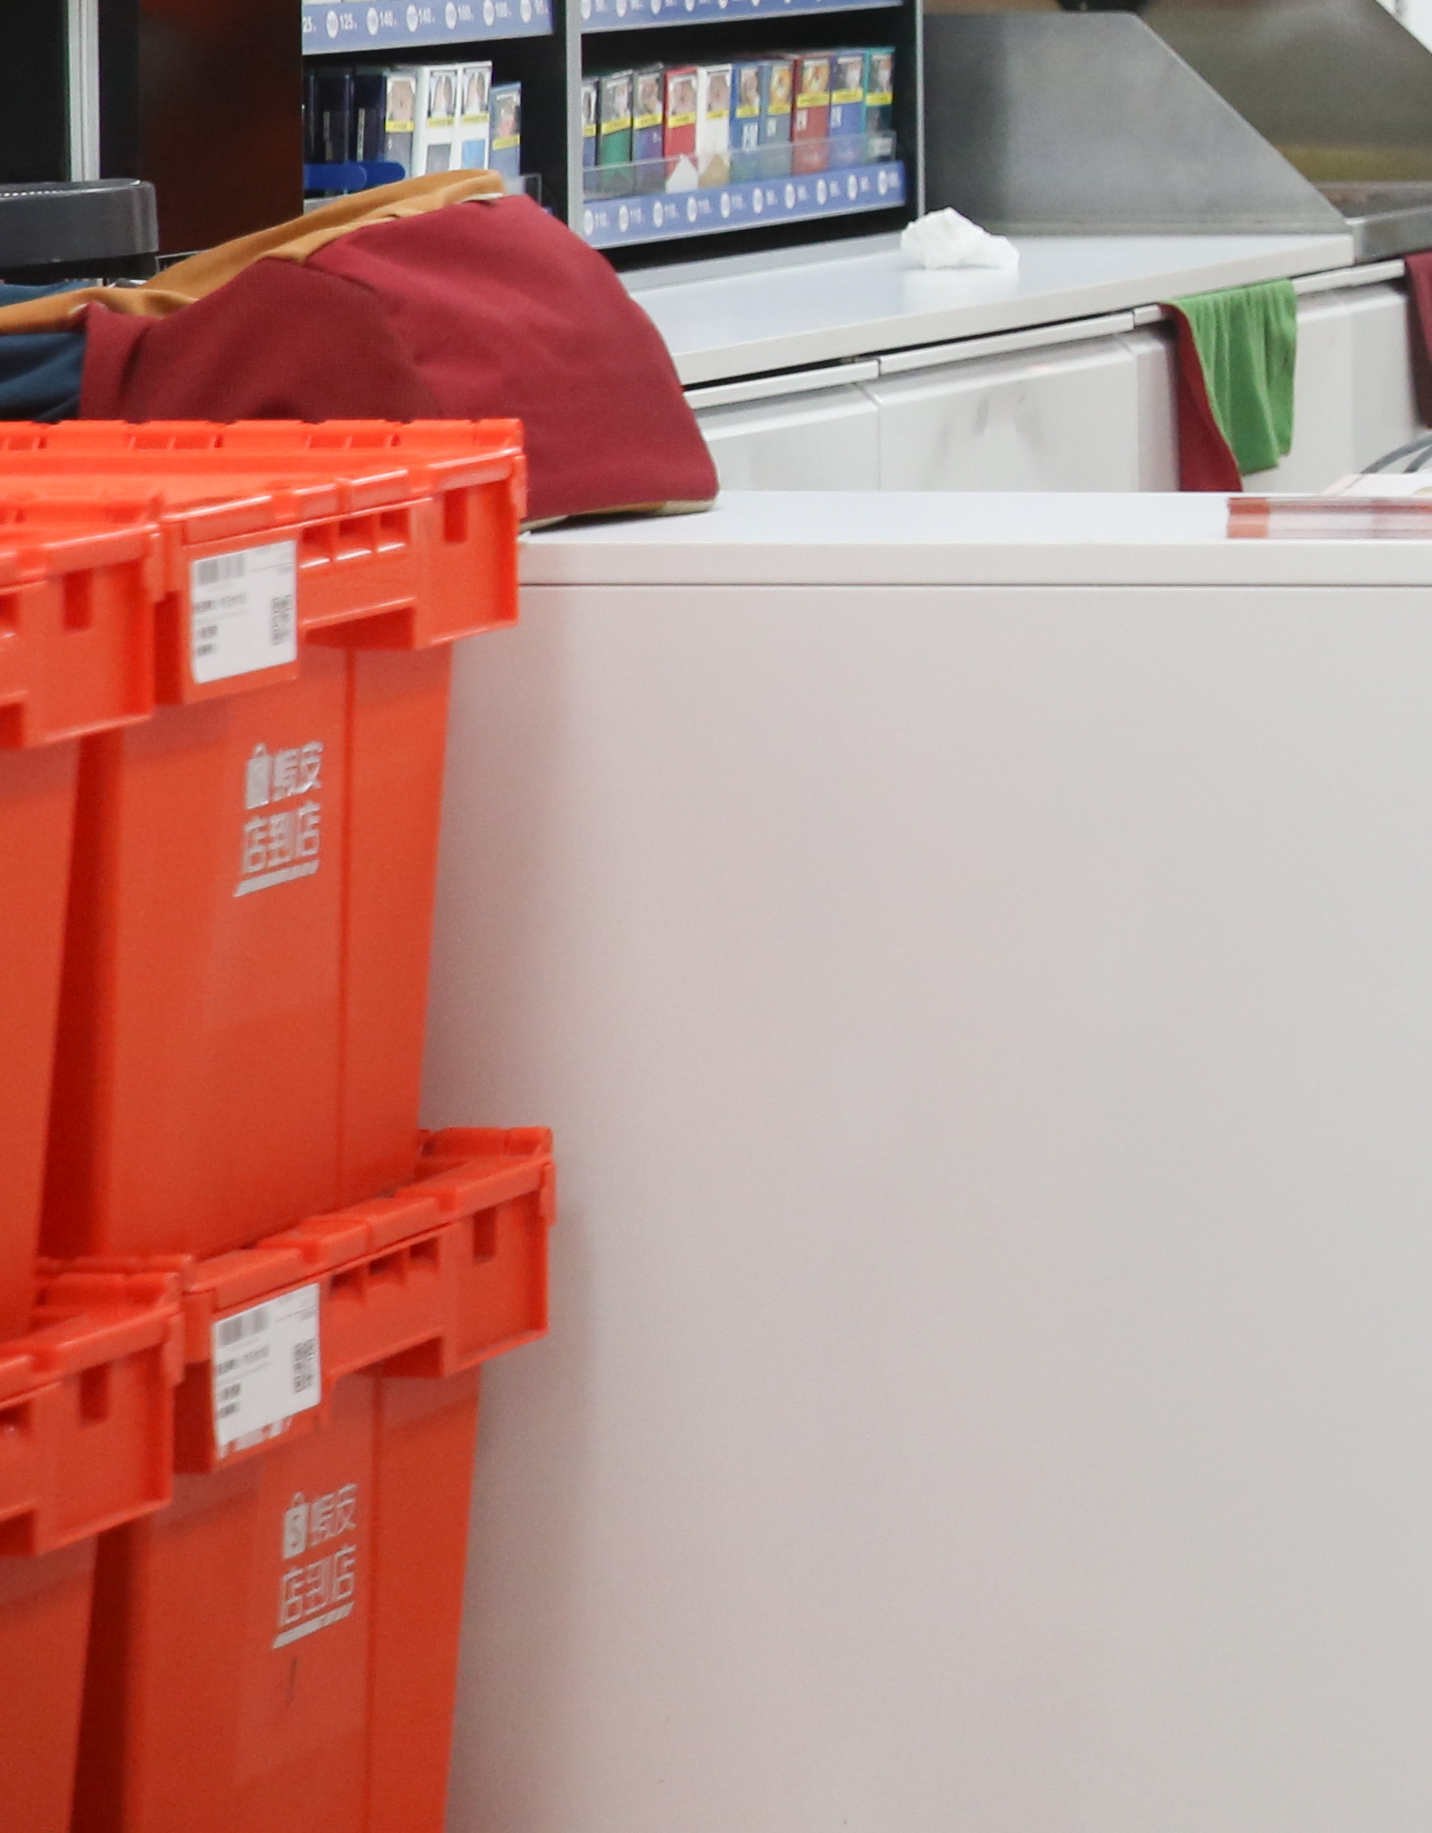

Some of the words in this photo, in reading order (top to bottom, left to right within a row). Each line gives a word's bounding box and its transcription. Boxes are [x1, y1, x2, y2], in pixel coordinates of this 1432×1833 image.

[244, 801, 320, 874] 店到店
[279, 1544, 356, 1627] 店到店
